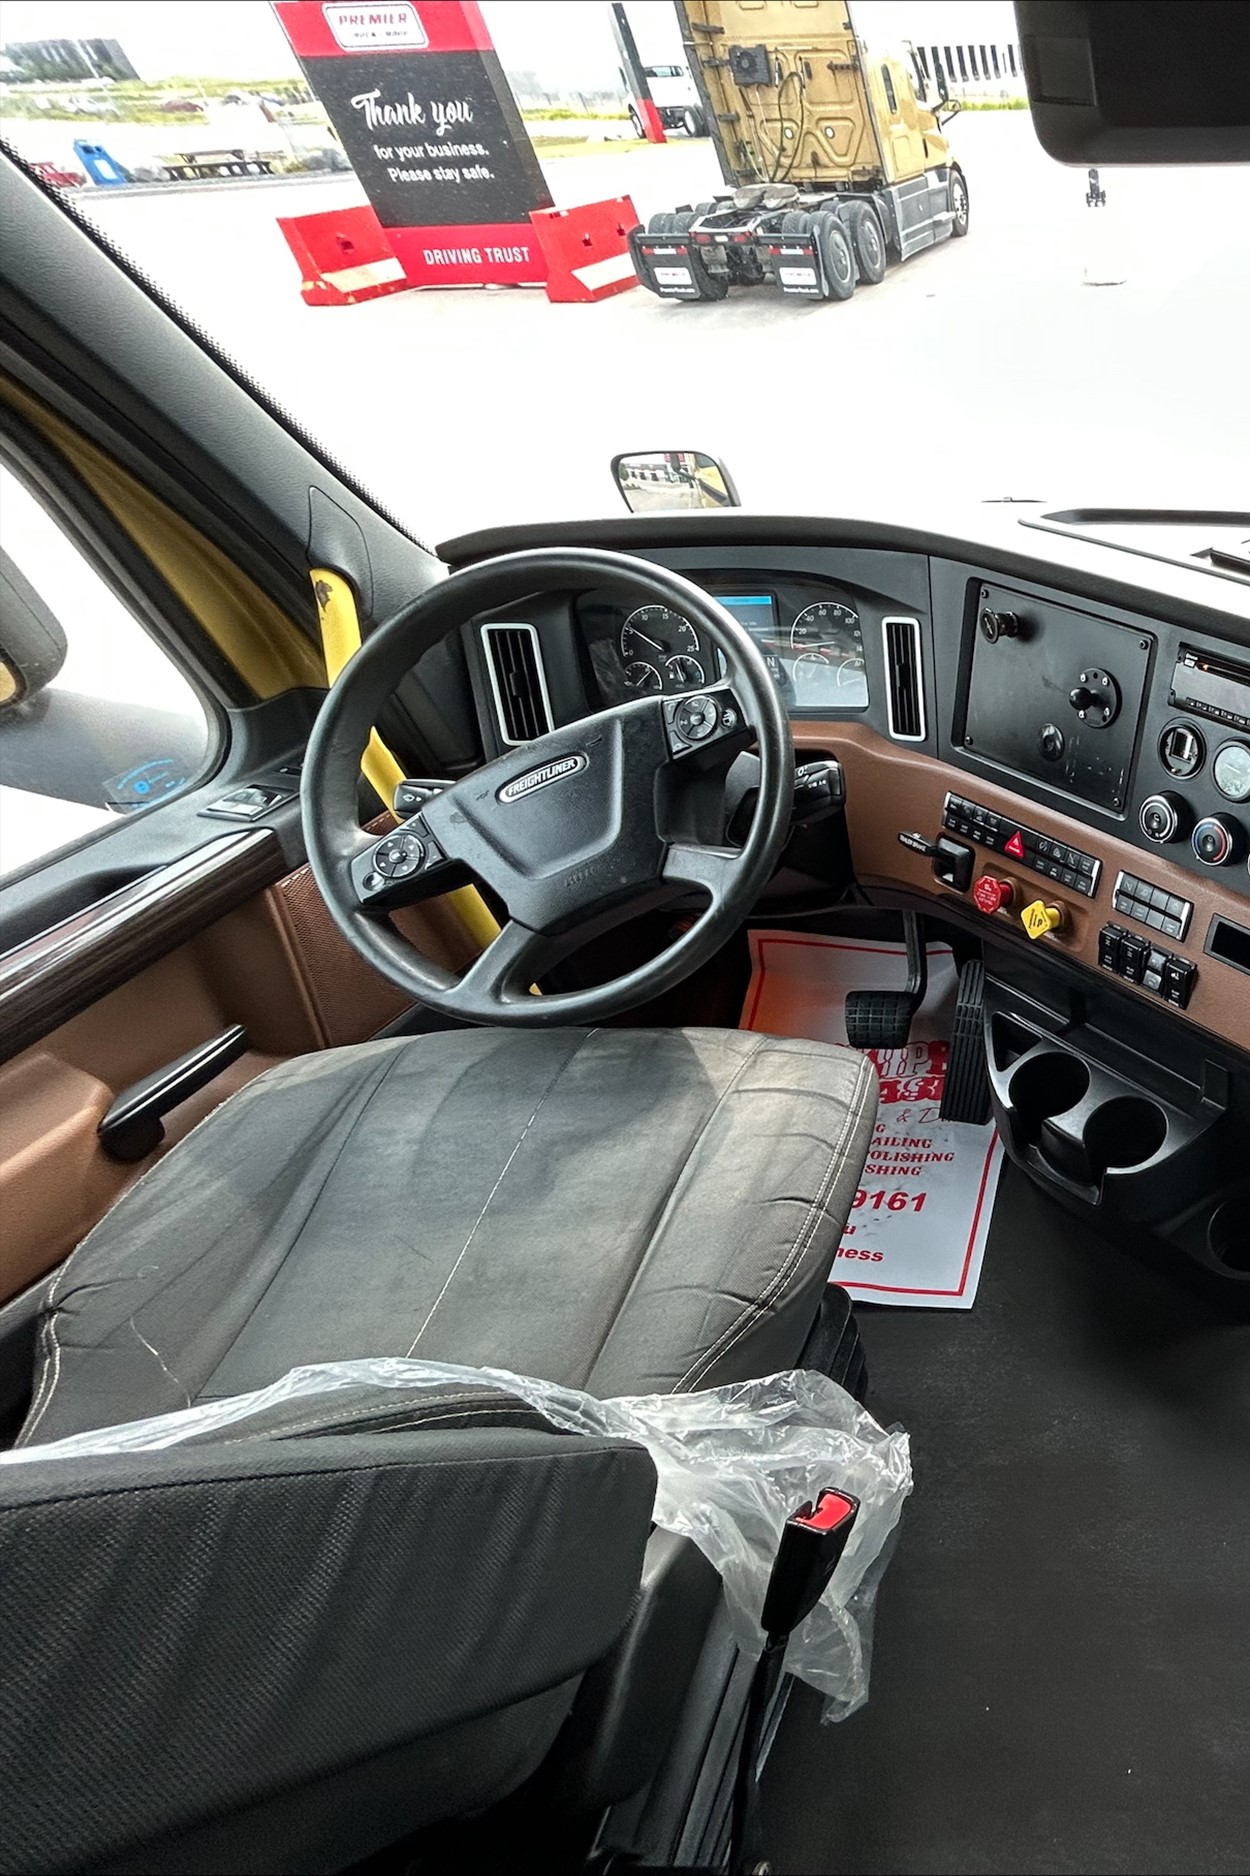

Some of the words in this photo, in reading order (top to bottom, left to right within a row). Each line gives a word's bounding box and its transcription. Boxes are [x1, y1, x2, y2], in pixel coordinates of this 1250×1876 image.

[338, 13, 408, 26] PREMIER
[351, 88, 426, 132] Thank
[430, 99, 474, 137] you
[373, 144, 395, 160] for
[395, 145, 425, 162] your
[424, 141, 490, 158] business.
[387, 166, 433, 183] Please
[433, 165, 461, 184] stay
[462, 163, 496, 181] safe.
[423, 247, 482, 265] DRIVING
[483, 246, 530, 263] TRUST
[766, 656, 776, 667] N
[508, 759, 576, 797] FREIGHTLINER
[871, 1136, 932, 1149] AILING
[868, 1150, 955, 1163] OLISHING
[865, 1164, 922, 1176] SHING
[852, 1188, 927, 1212] 9161
[837, 1246, 885, 1262] ness
